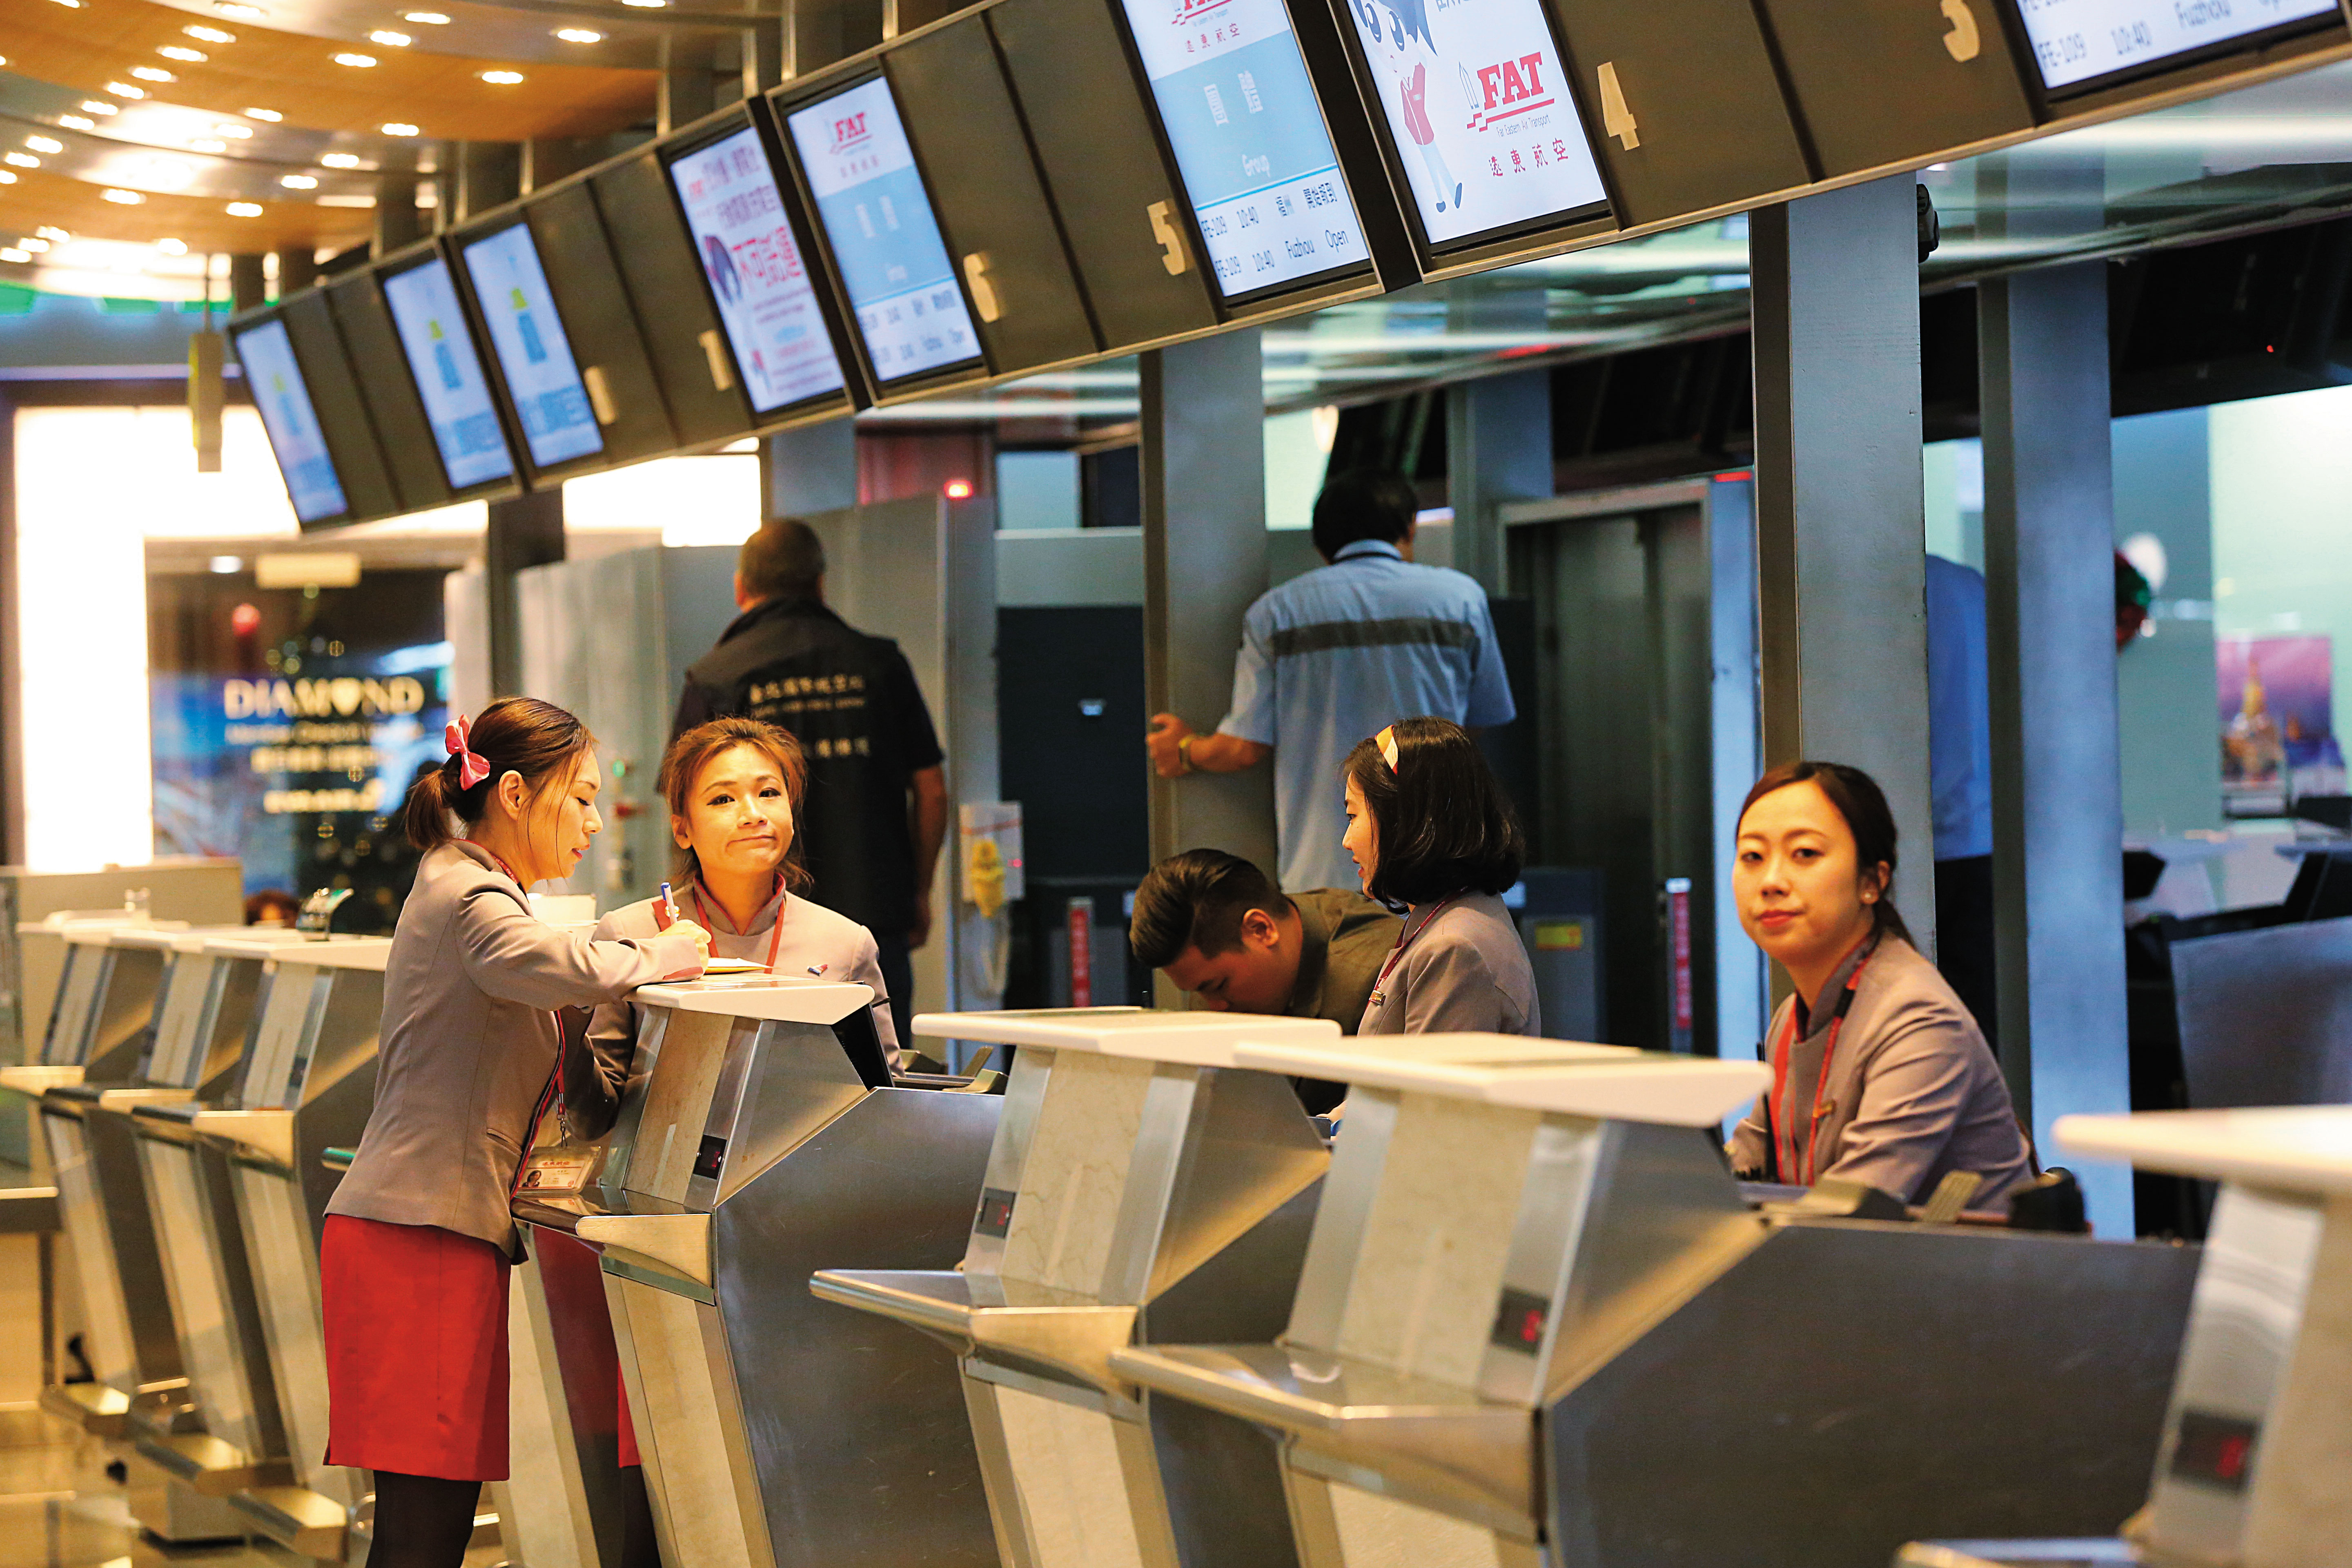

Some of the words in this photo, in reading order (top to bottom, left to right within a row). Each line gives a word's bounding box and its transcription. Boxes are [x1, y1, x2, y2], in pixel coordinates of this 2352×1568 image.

[1477, 51, 1544, 110] FAT
[835, 112, 866, 142] FAT
[1496, 127, 1504, 137] Far
[1504, 123, 1521, 135] Eastern
[1528, 114, 1550, 128] Transport
[1597, 61, 1640, 151] 4
[1242, 154, 1271, 177] Group
[1147, 200, 1186, 276] 5
[1236, 206, 1260, 228] 10:40
[1252, 249, 1275, 272] 10:40
[1285, 237, 1316, 259] Fuzhou
[1324, 229, 1349, 253] Open
[963, 253, 1000, 324] 6
